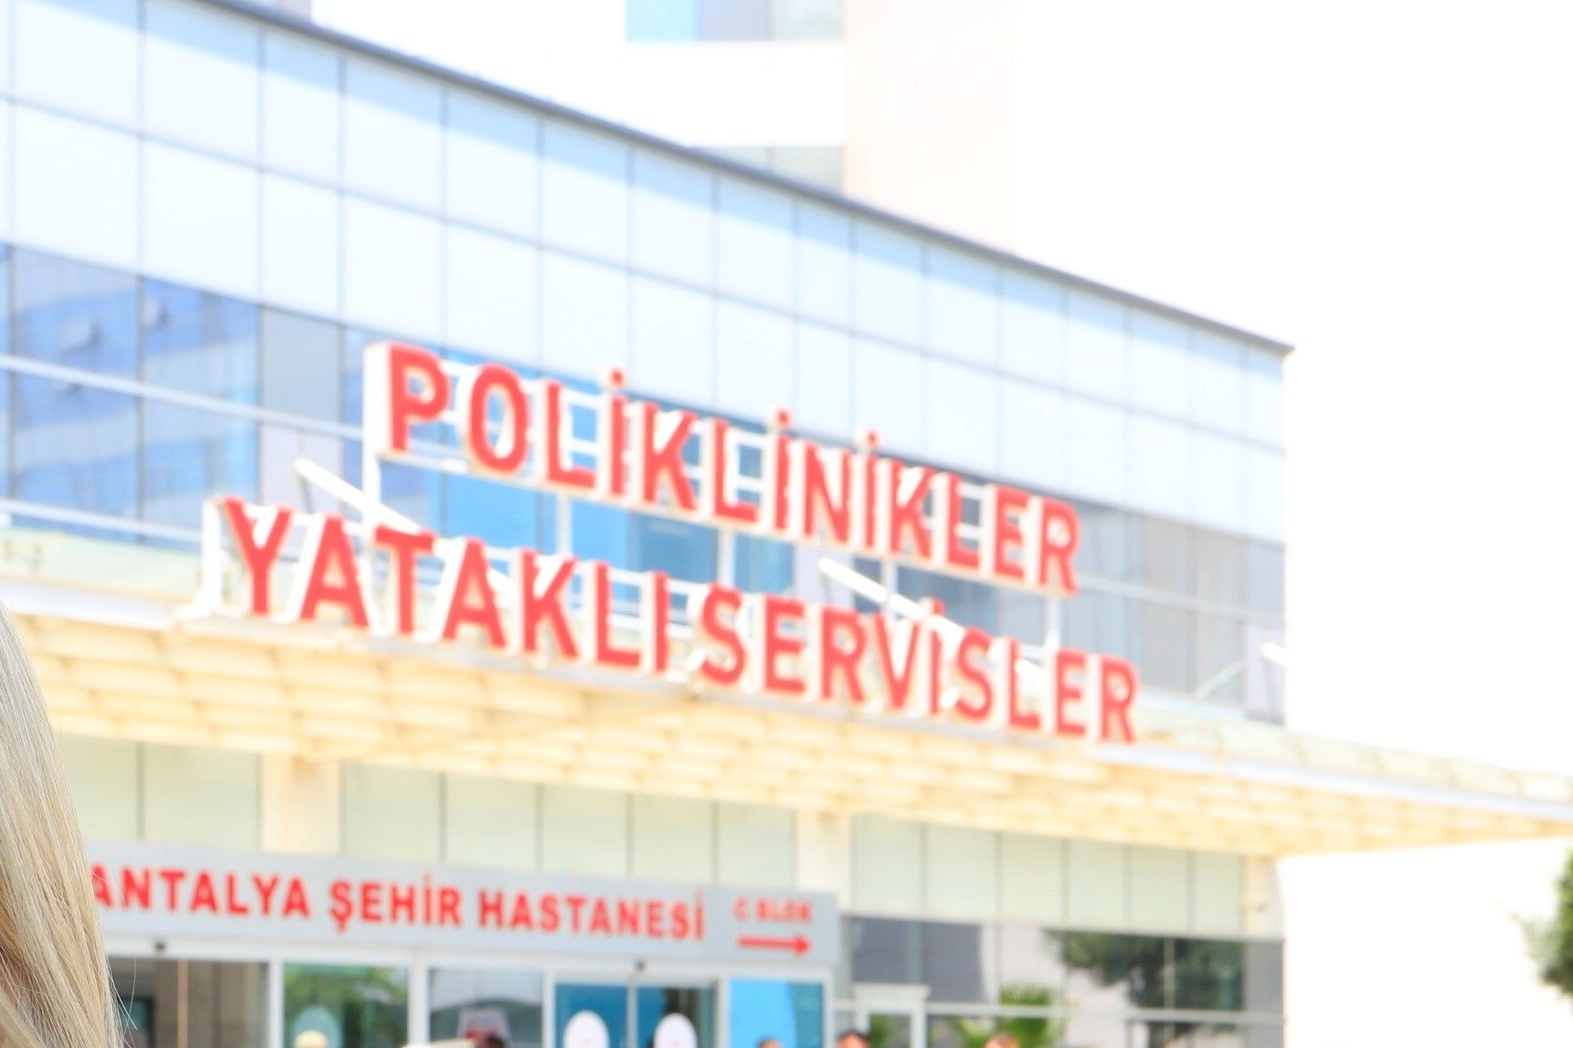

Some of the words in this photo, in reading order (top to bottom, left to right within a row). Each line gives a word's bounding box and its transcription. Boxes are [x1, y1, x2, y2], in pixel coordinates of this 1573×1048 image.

[387, 343, 1080, 595] POLİKLİNİKLER
[222, 496, 672, 675] YATAKLI
[697, 582, 1139, 746] SERVİSLER
[90, 863, 312, 920] ANTALYA
[329, 873, 463, 934] ŞEHİR
[478, 889, 705, 941] HASTANESİ
[754, 896, 813, 925] BLOK
